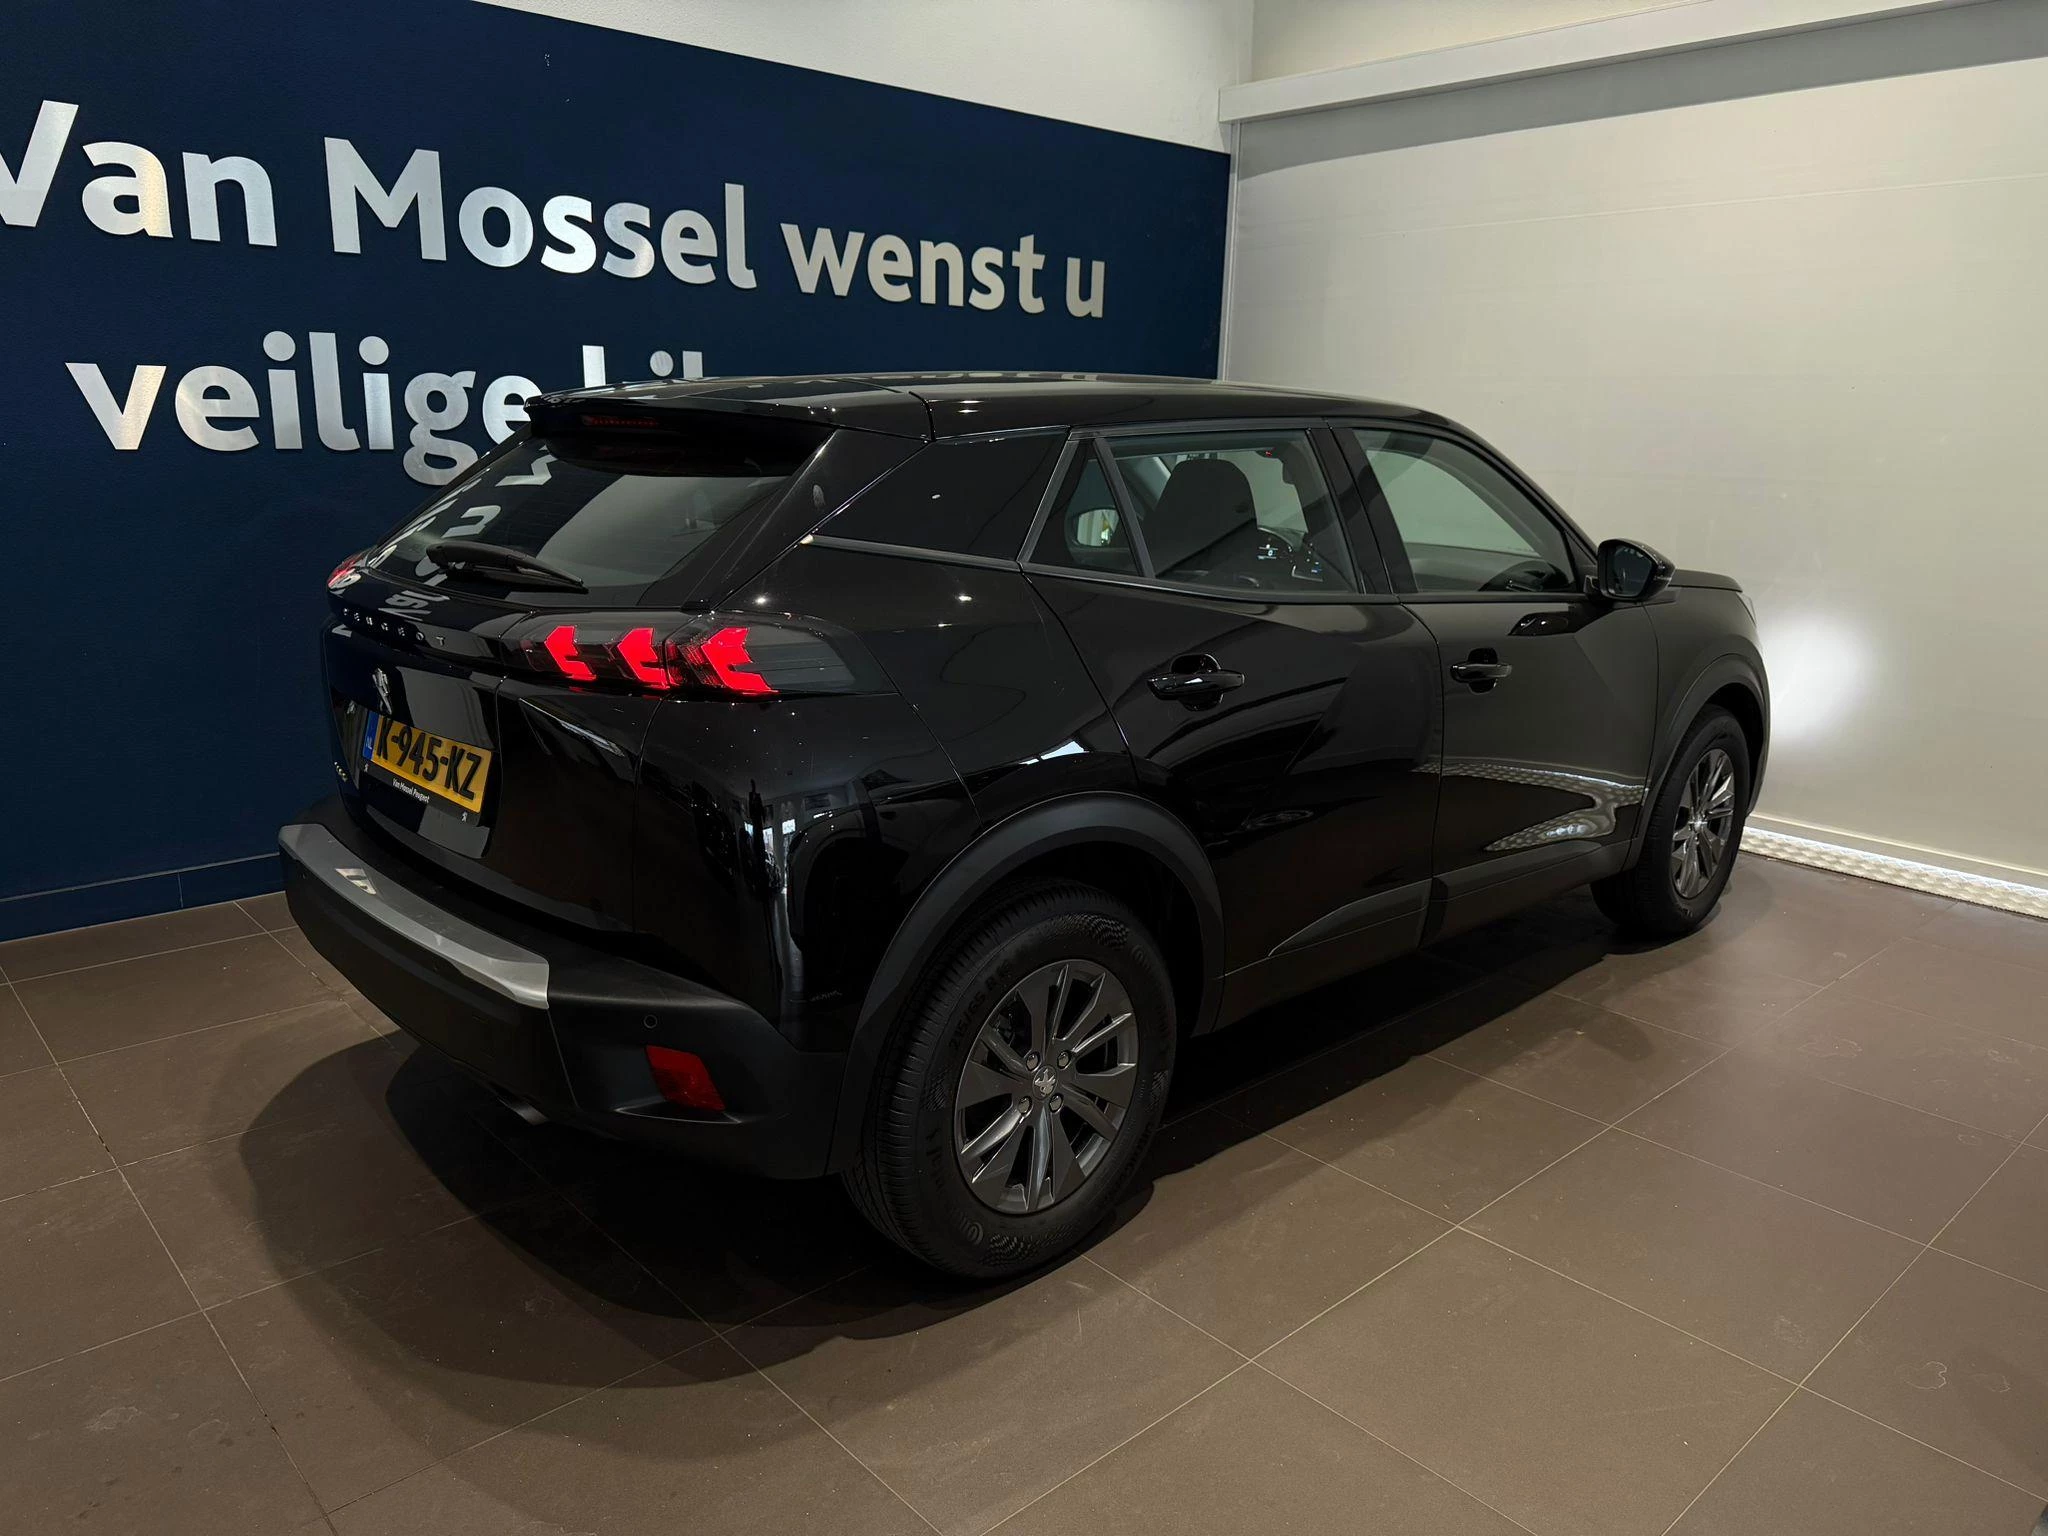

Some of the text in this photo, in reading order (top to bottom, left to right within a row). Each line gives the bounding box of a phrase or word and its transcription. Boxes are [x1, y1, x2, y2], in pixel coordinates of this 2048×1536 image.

[0, 99, 1105, 318] Van Mossel wenst u
[65, 330, 528, 486] veilige
[377, 717, 482, 800] K-945-KZ
